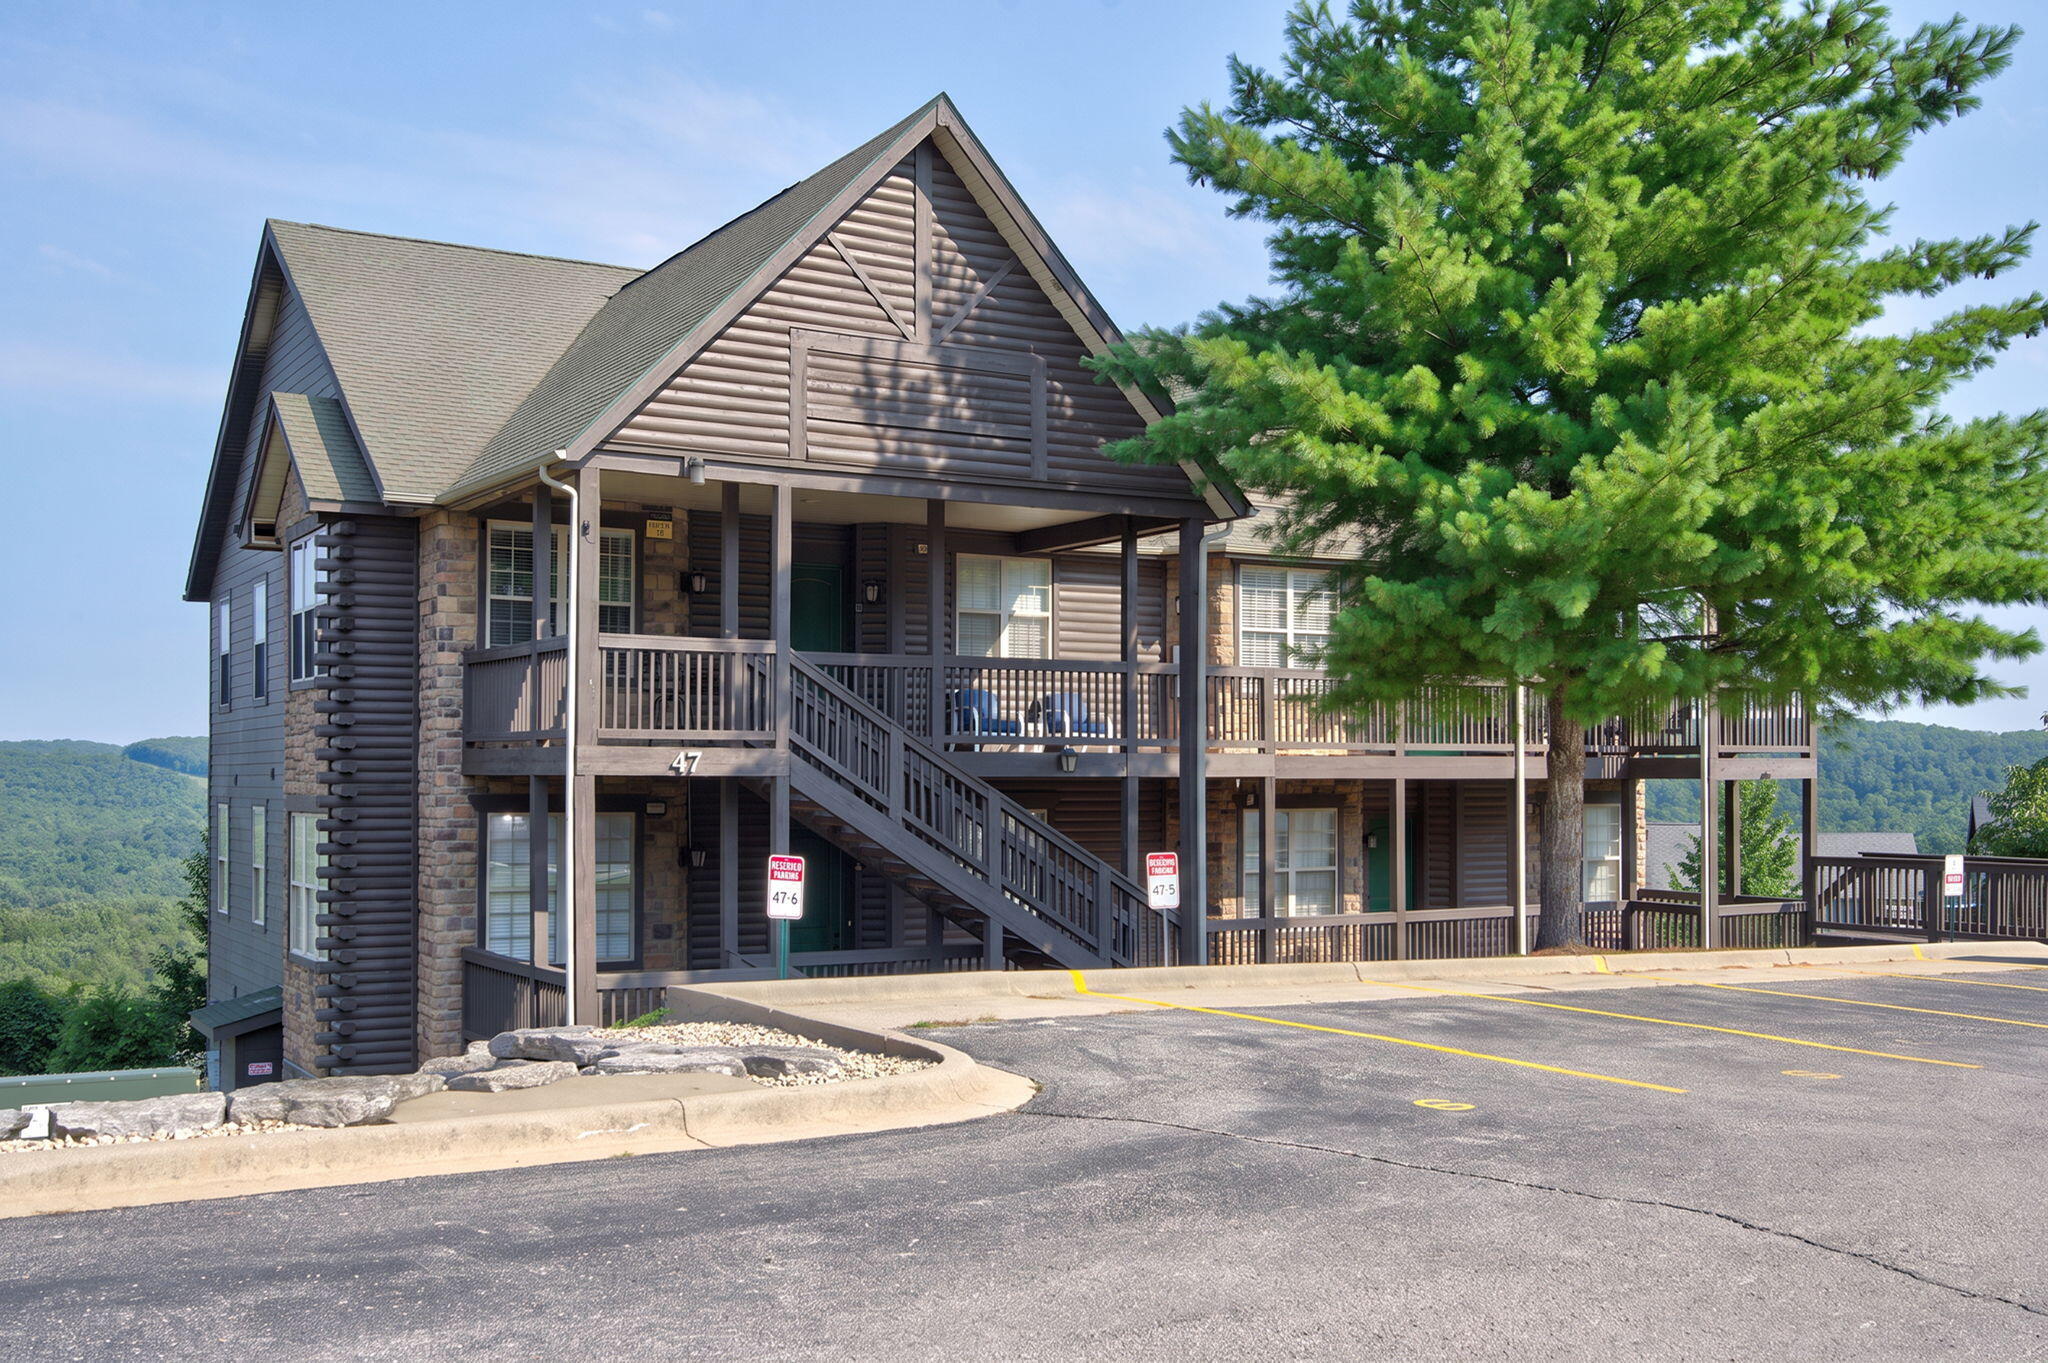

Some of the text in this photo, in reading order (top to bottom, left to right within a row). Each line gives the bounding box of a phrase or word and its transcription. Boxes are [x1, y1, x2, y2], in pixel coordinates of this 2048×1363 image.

[672, 751, 702, 773] 47
[1152, 883, 1176, 896] 47-5
[772, 891, 798, 905] 47-6
